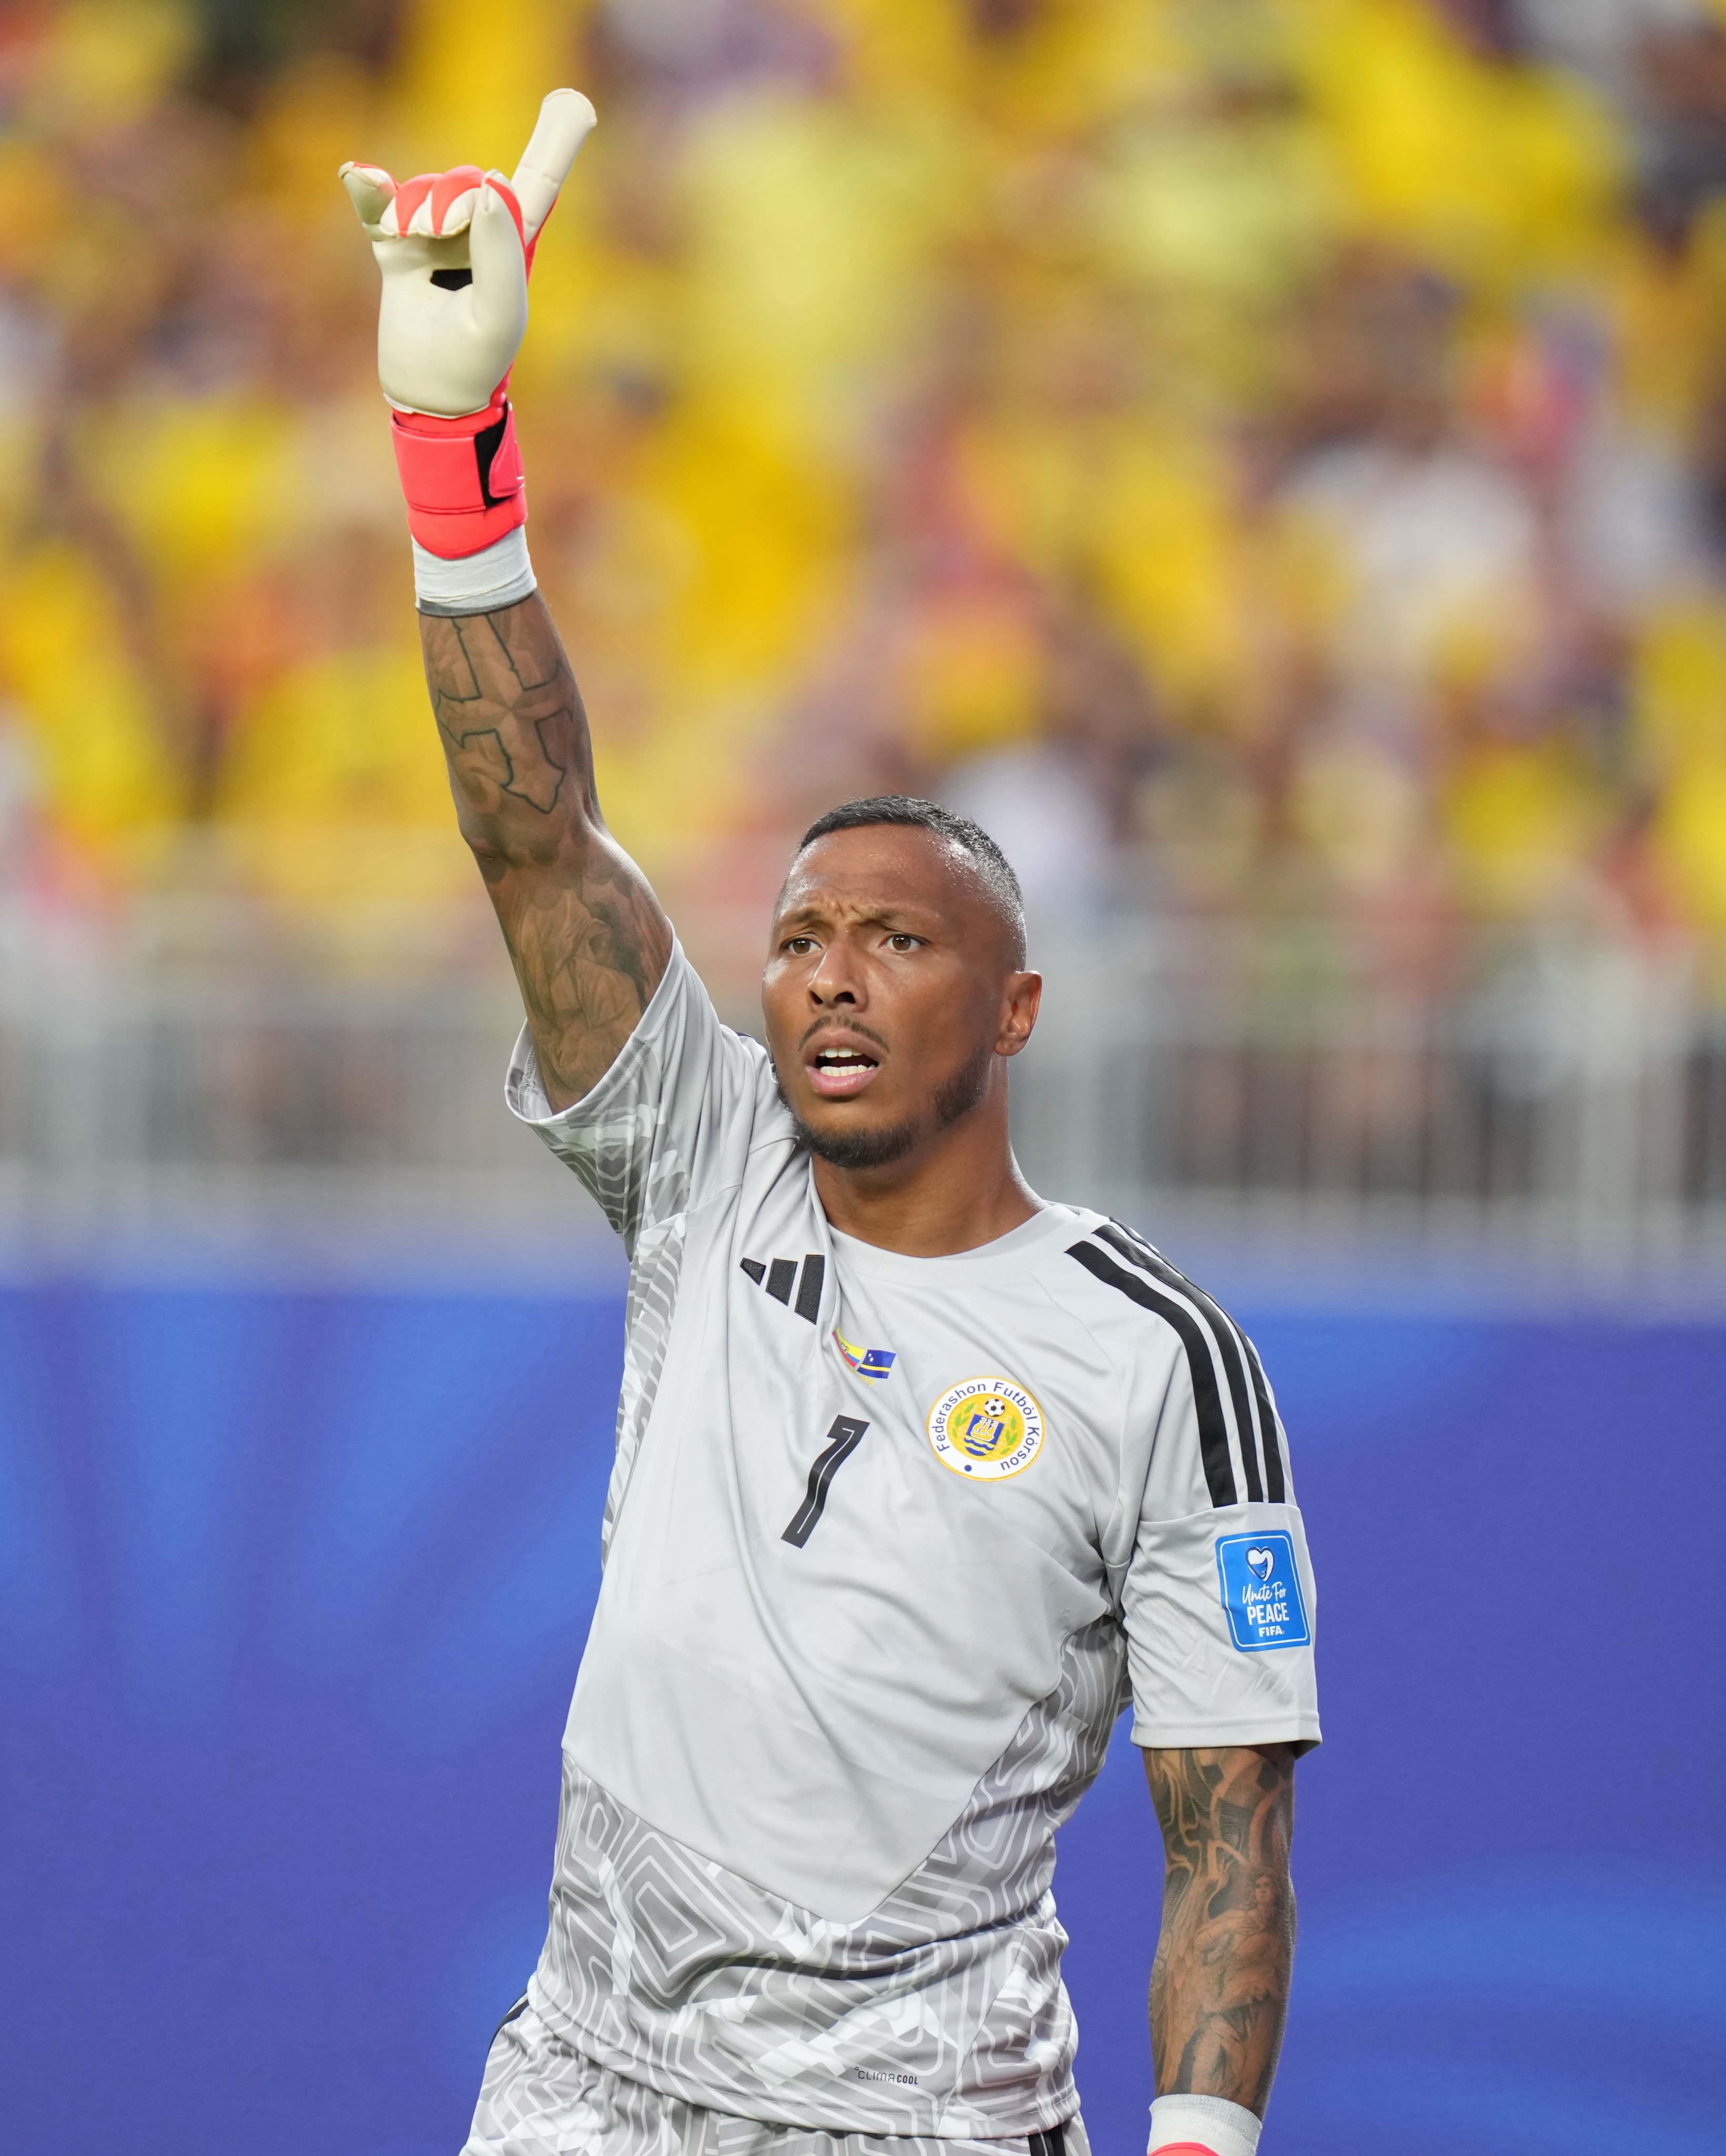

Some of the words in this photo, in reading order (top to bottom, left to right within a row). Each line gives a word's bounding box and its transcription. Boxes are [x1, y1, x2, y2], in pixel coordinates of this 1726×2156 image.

[993, 1382, 1038, 1420] Futbòl
[932, 1383, 986, 1452] Federashon
[1000, 1426, 1040, 1470] Kòrsou
[1242, 1583, 1272, 1605] Unite
[1271, 1581, 1286, 1601] For
[1247, 1602, 1289, 1625] PEACE
[1258, 1625, 1284, 1637] FIFA
